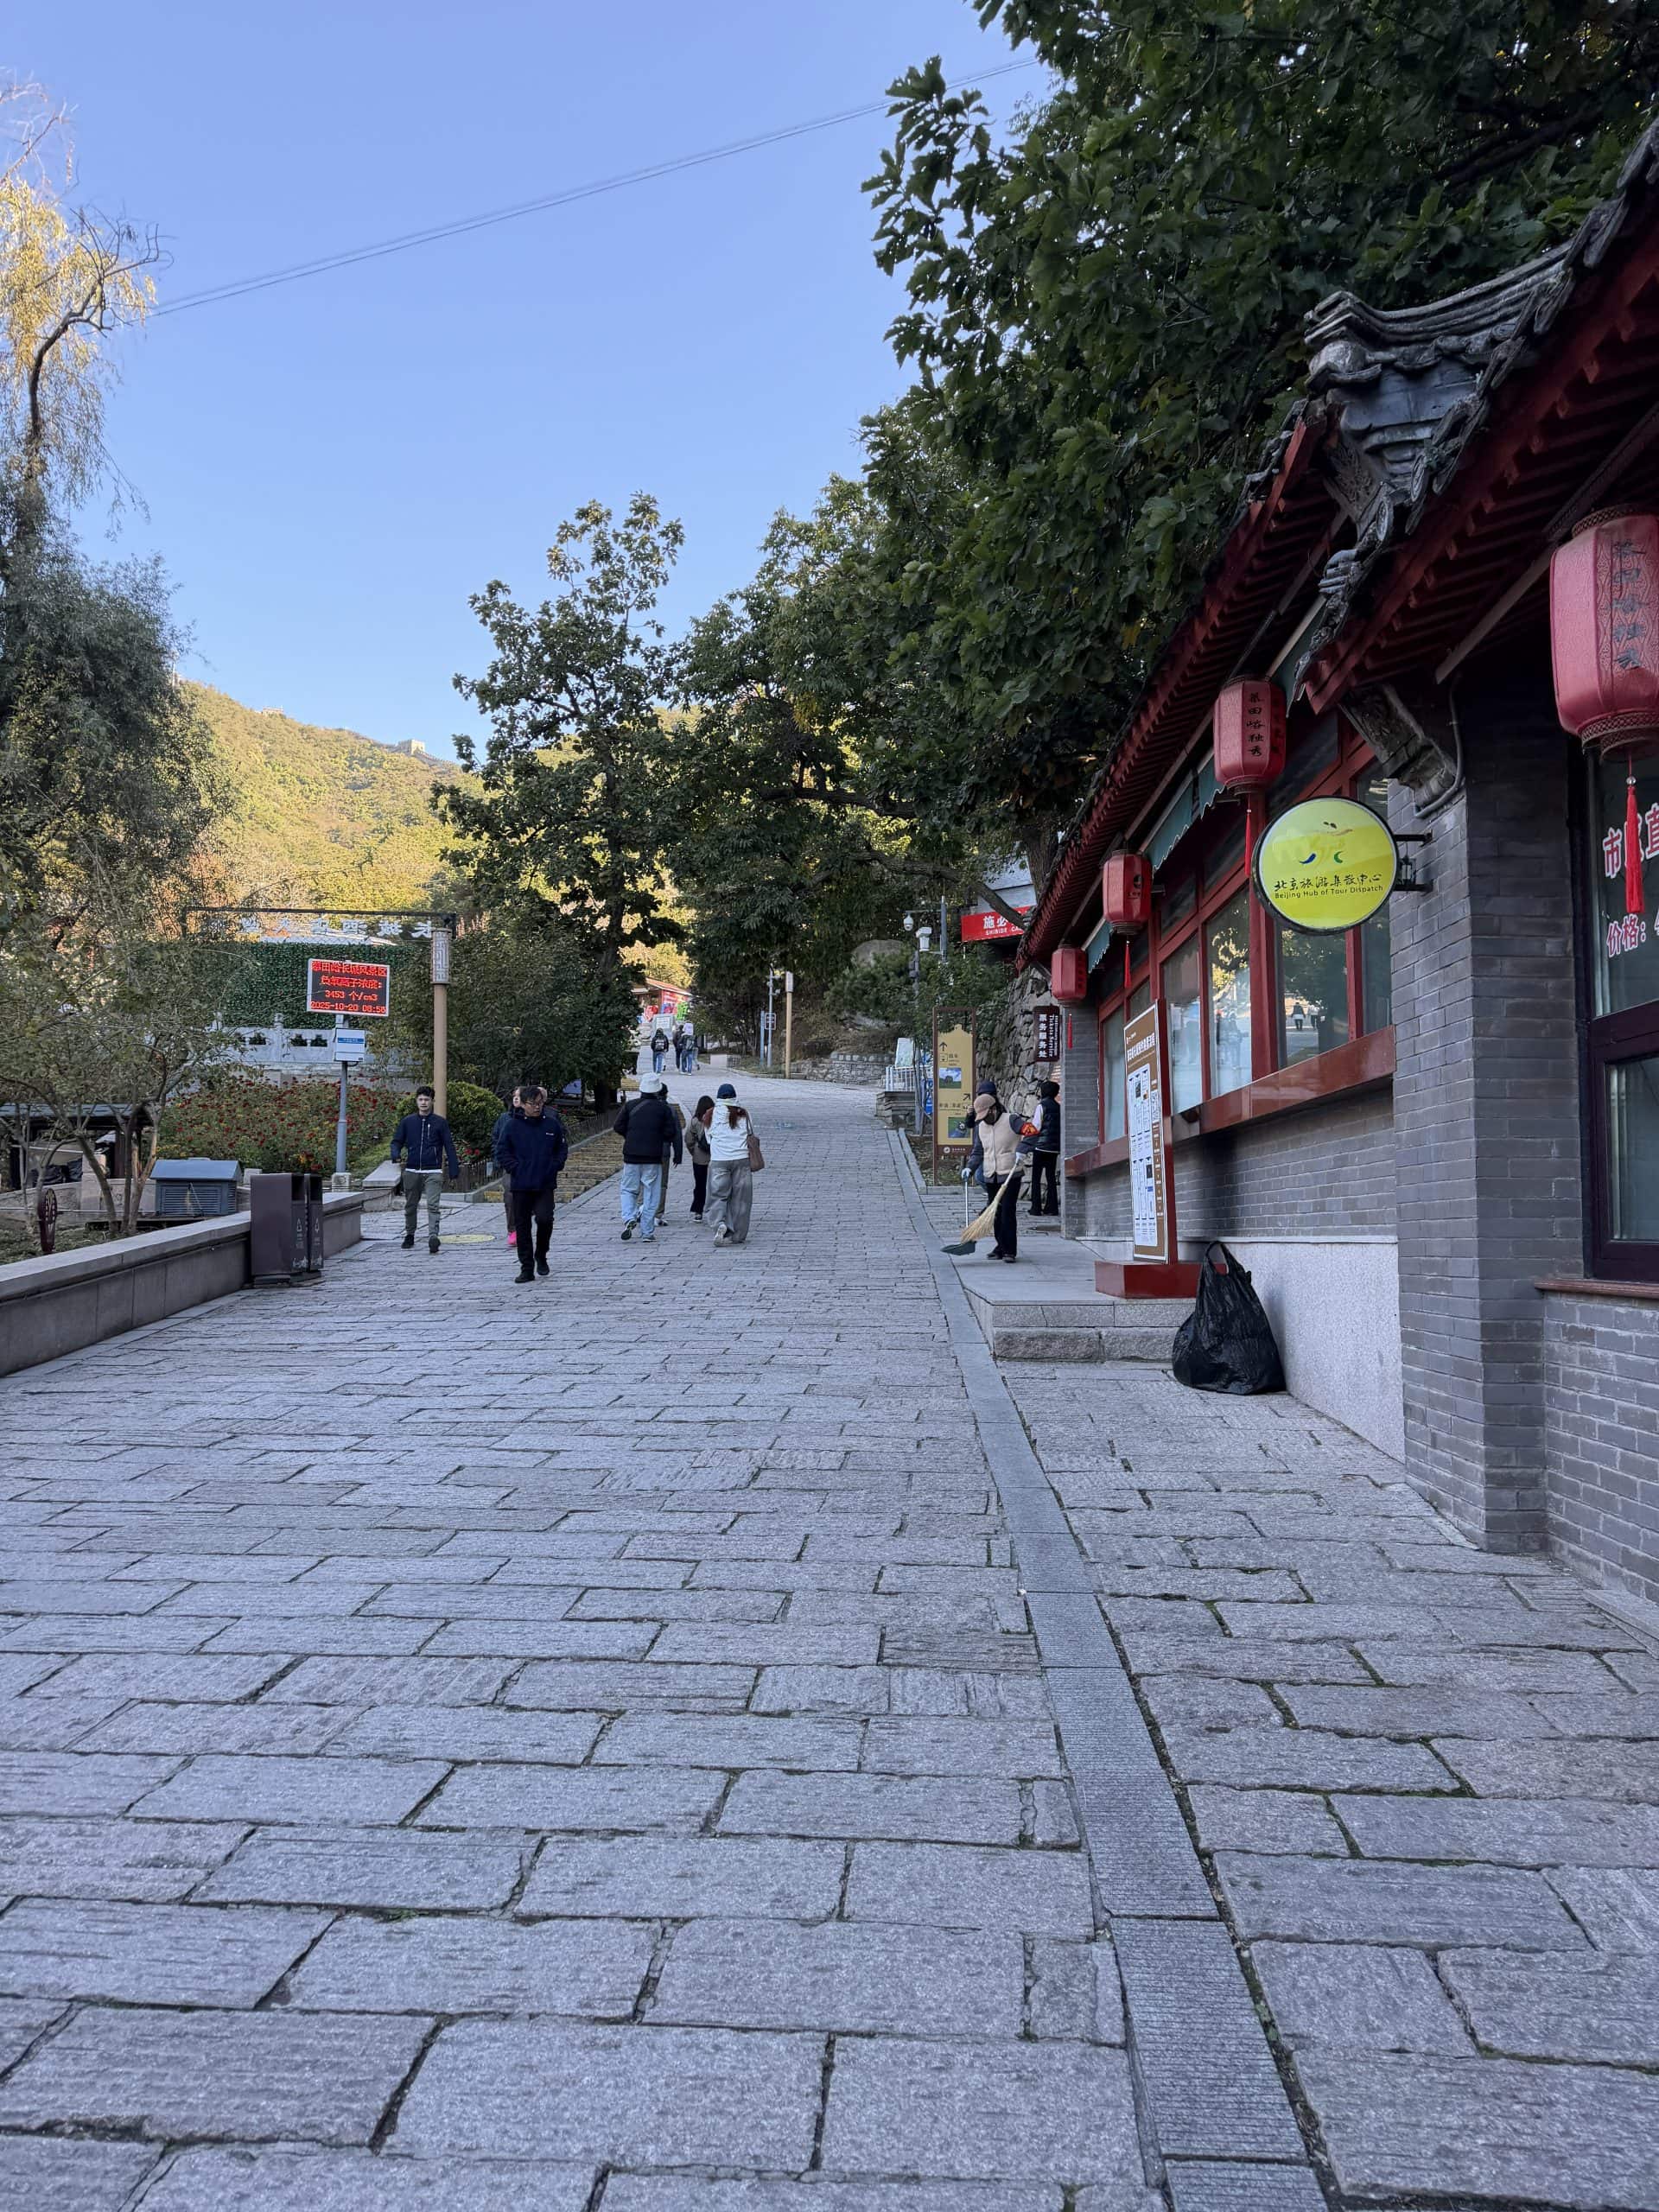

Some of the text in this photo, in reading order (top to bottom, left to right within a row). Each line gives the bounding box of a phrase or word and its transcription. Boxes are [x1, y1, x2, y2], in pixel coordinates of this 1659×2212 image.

[1274, 873, 1382, 892] 北京旅游集散中心
[1351, 885, 1383, 893] Dispatch
[310, 1001, 359, 1012] 2025-10-20
